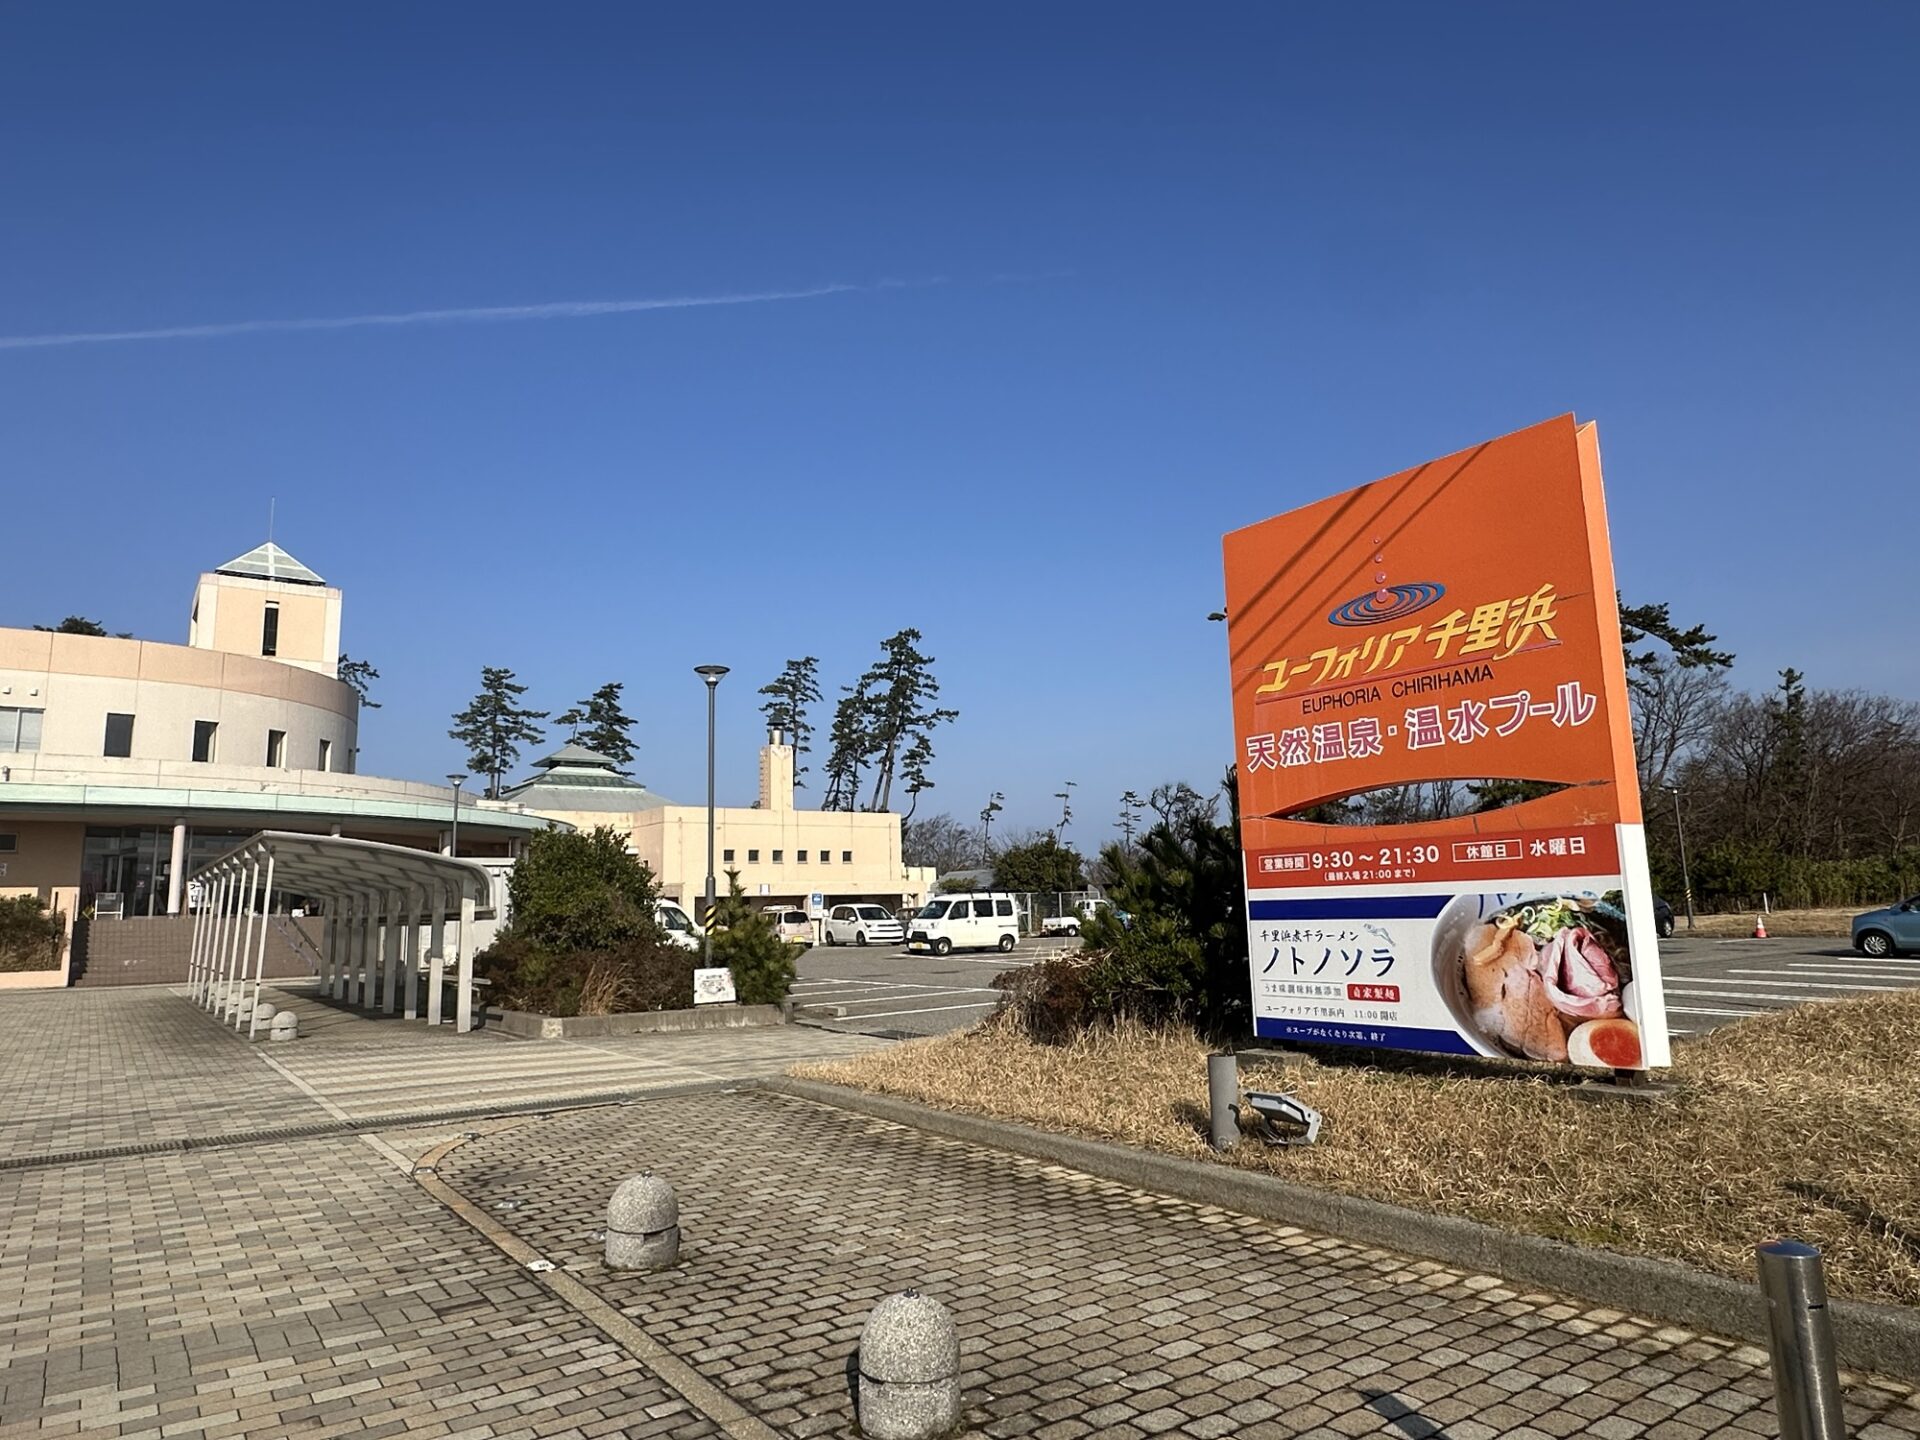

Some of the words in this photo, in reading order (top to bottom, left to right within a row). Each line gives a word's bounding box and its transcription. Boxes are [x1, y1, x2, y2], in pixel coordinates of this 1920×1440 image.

[1256, 583, 1558, 694] ユーフォリア千里浜
[1302, 686, 1381, 715] EUPHORIA
[1391, 664, 1494, 698] CHIRIHAMA
[1246, 681, 1597, 773] 天然温泉・温水プール
[1263, 856, 1305, 871] 営業時間
[1466, 844, 1506, 859] 休館日
[1530, 837, 1586, 857] 水曜日
[1260, 929, 1360, 943] 千里浜煮干ラーメン
[1262, 946, 1396, 977] ノトノソラ
[1264, 983, 1342, 997] うま味調味料無添加
[1265, 1004, 1345, 1018] ユーフォリア千里浜内
